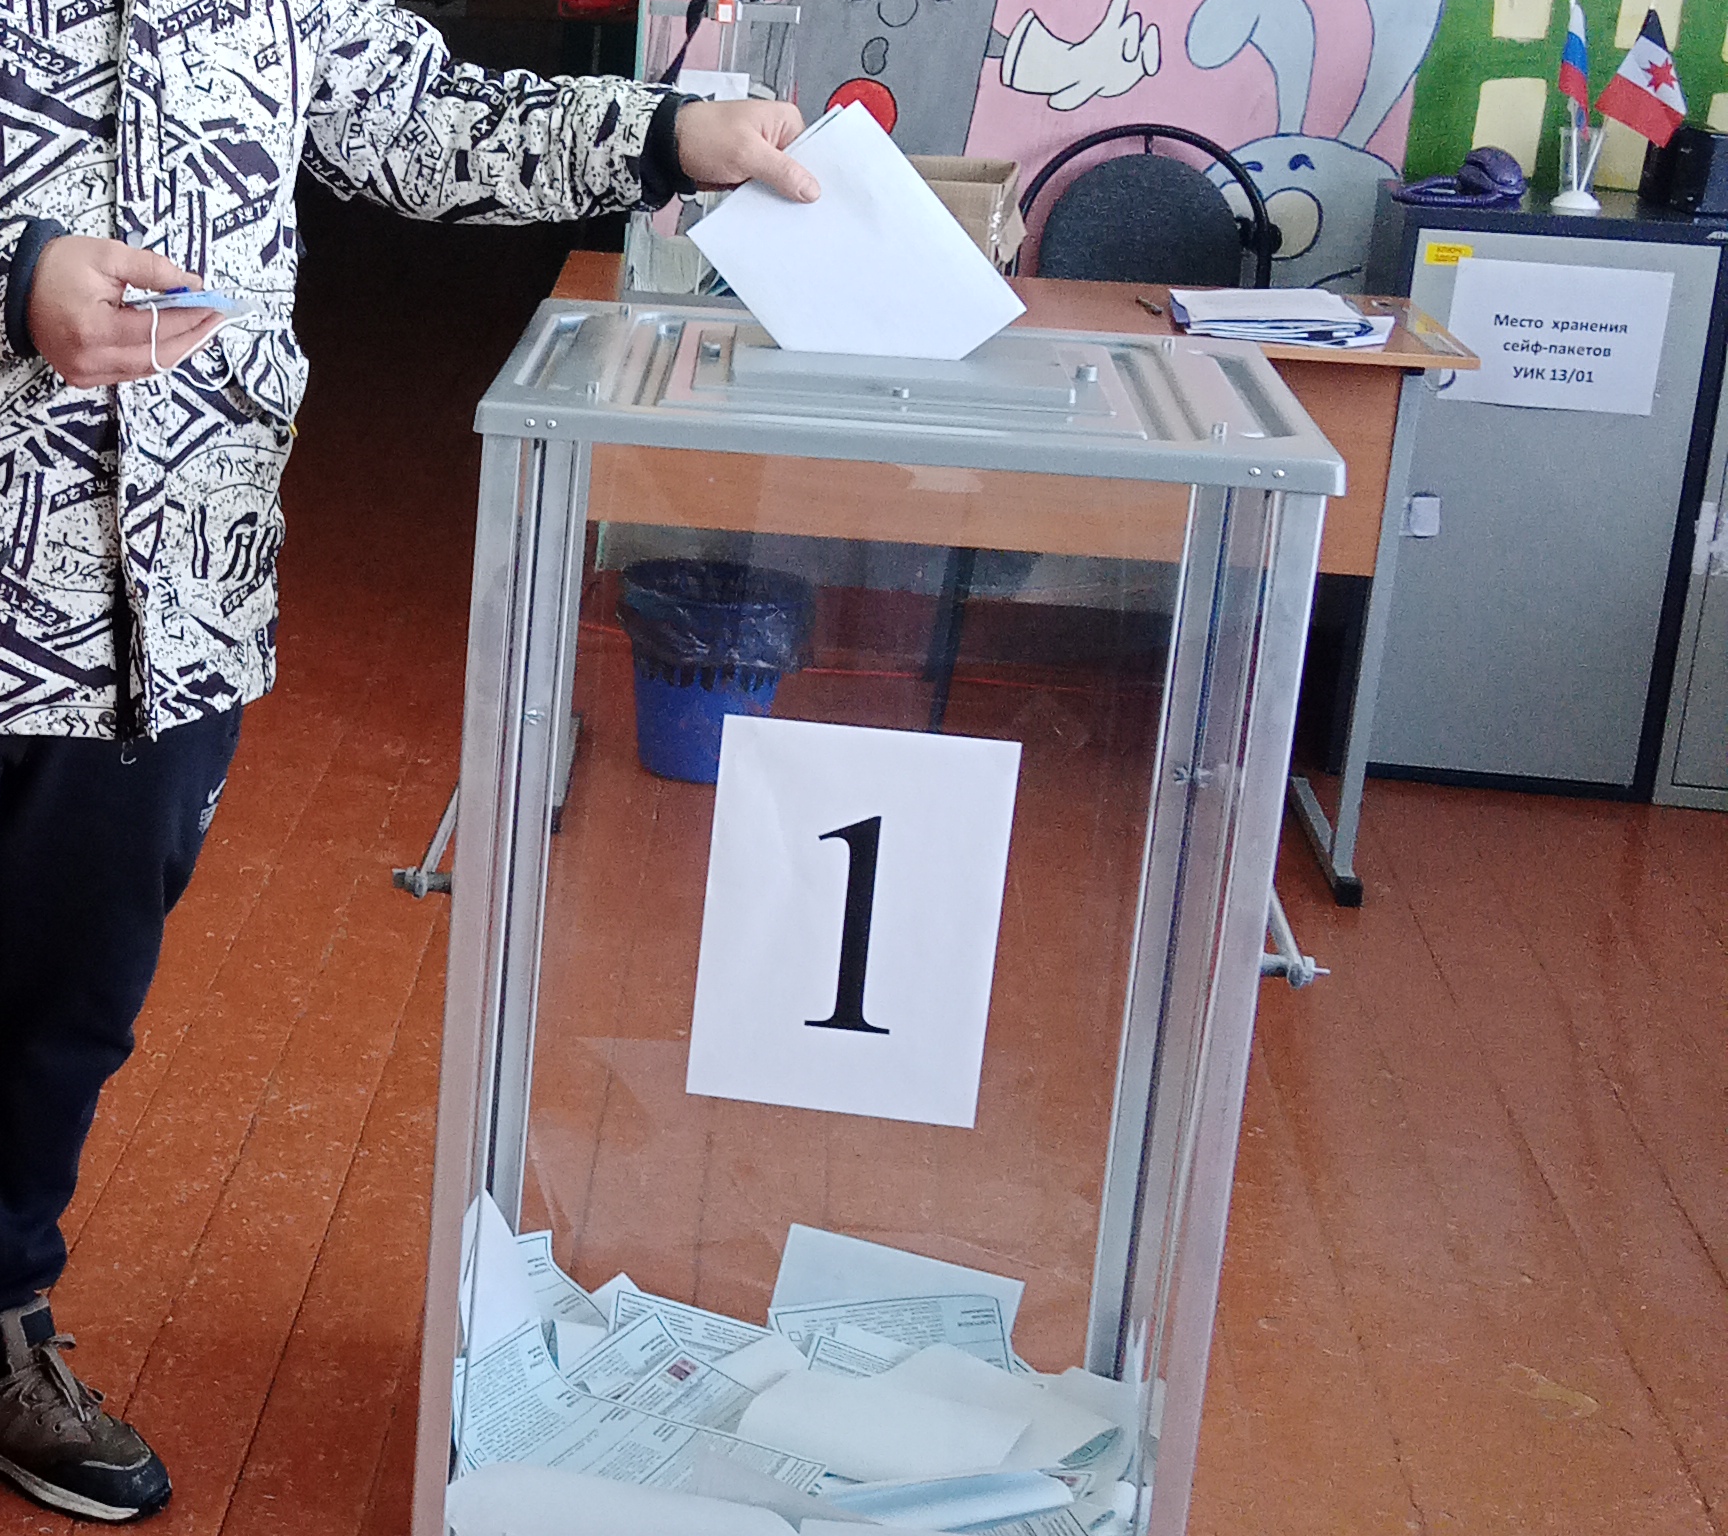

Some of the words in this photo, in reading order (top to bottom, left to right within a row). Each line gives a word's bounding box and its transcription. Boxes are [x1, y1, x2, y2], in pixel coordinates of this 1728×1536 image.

[1493, 313, 1544, 329] Место
[1551, 319, 1628, 334] хранения
[1503, 339, 1612, 357] сейф-пакетов
[1512, 366, 1545, 380] УИК
[1549, 368, 1594, 384] 13/01
[804, 815, 890, 1035] 1
